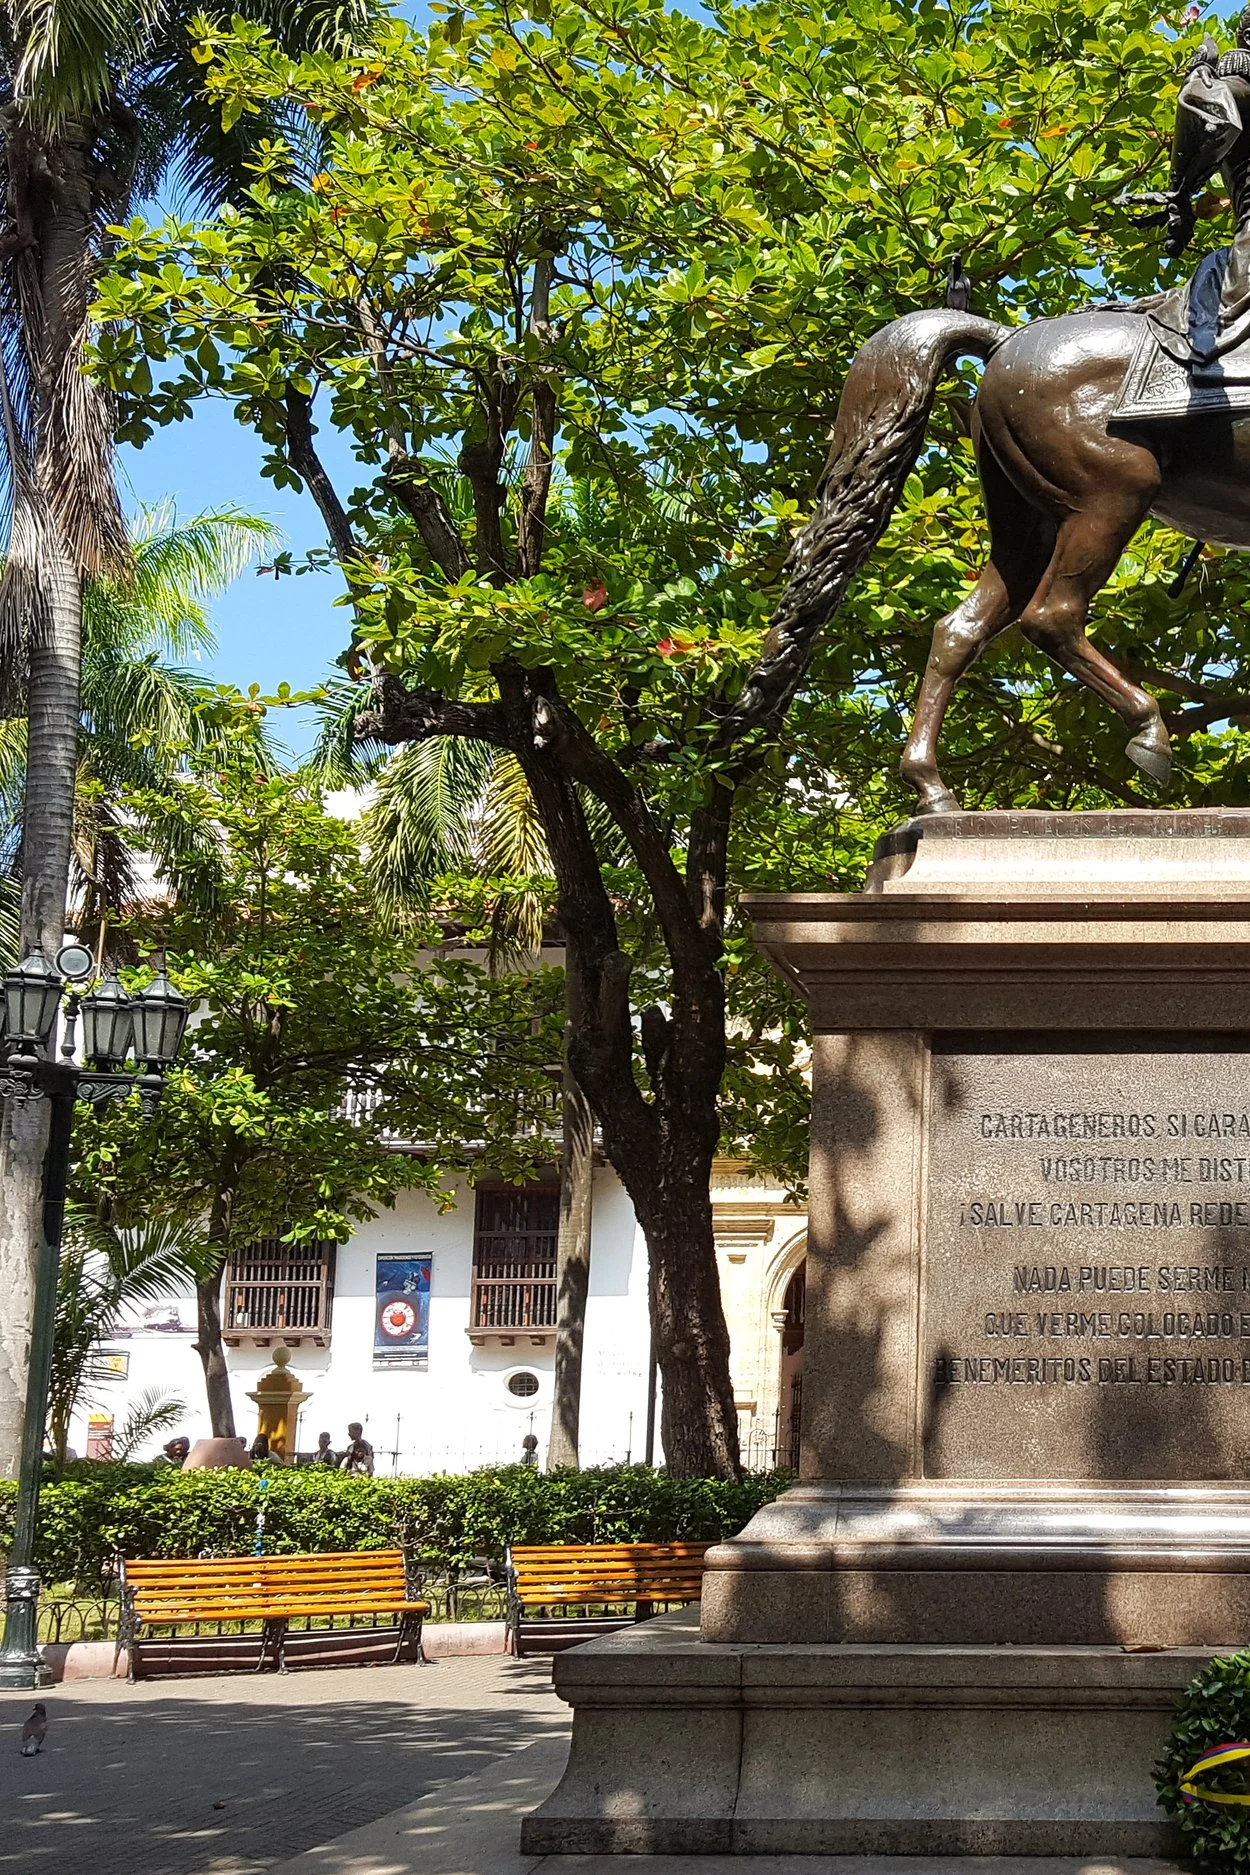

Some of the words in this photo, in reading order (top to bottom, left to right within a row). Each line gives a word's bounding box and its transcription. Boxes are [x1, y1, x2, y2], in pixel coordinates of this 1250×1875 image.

[1167, 1114, 1187, 1138] SI
[1039, 1157, 1158, 1183] VOSOTROS
[1162, 1158, 1192, 1183] ME
[1050, 1202, 1180, 1227] CARTAGENA
[1014, 1266, 1072, 1294] NADA
[1079, 1266, 1150, 1294] PUEDE
[1158, 1266, 1235, 1294] SERME
[985, 1312, 1028, 1338] QUE
[1037, 1312, 1111, 1338] VERME
[1117, 1312, 1235, 1338] COLOCADO
[1100, 1358, 1142, 1385] DEL
[1149, 1358, 1235, 1385] ESTADO
